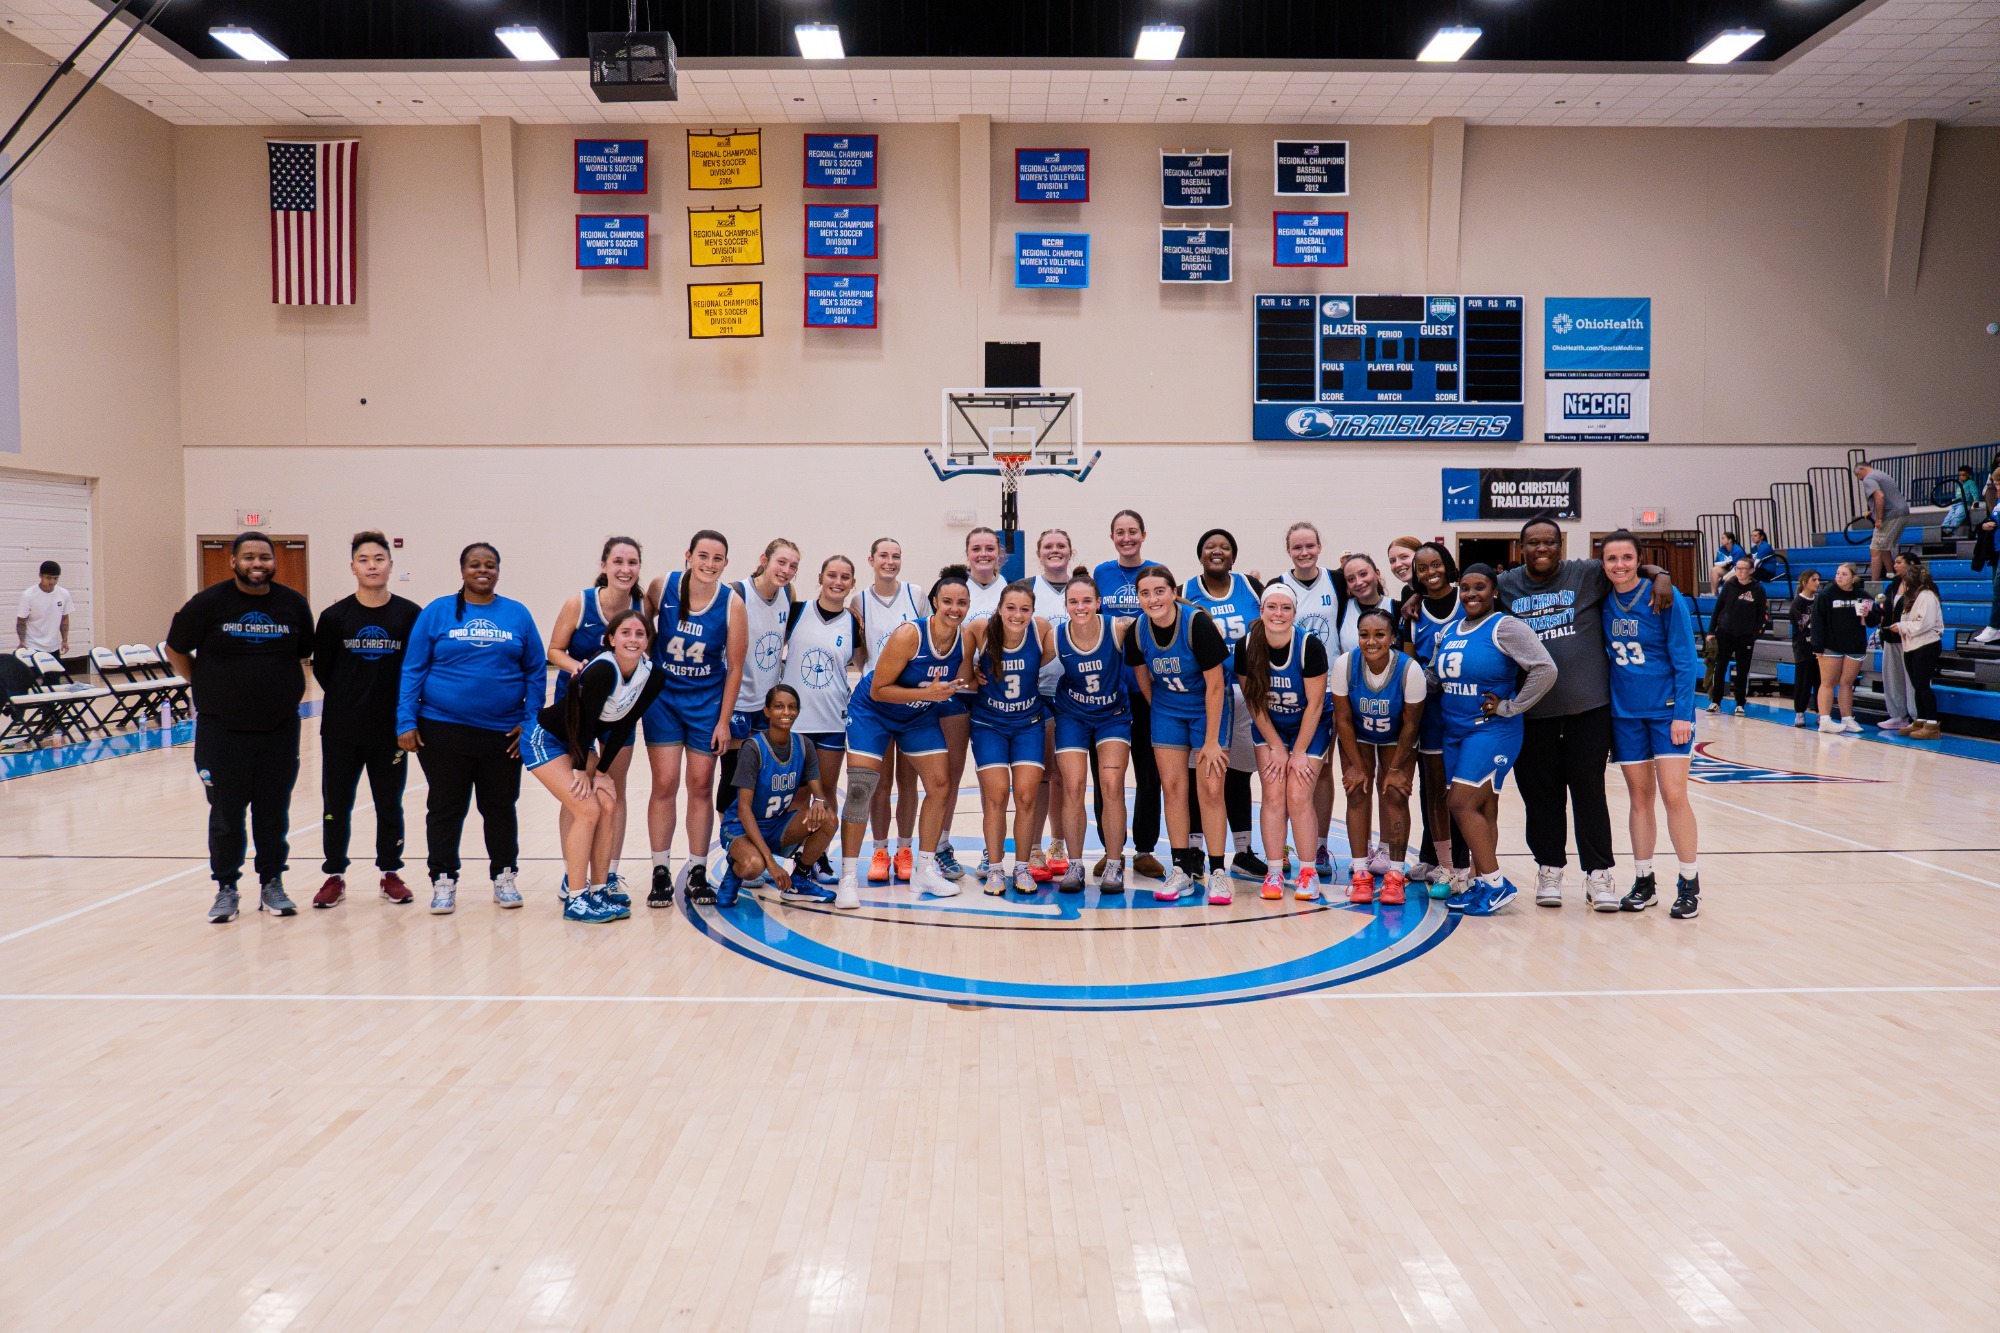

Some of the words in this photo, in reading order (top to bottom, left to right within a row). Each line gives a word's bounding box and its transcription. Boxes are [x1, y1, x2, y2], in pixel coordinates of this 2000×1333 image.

[723, 148, 757, 157] CHAMPIONS
[808, 150, 837, 158] REGIONAL
[722, 158, 746, 166] SOCCER
[710, 168, 735, 176] DIVISION
[1165, 169, 1193, 177] REGIONAL
[1194, 169, 1227, 177] CHAMPIONS
[1297, 166, 1326, 174] BASEBALL
[1182, 187, 1207, 195] DIVISION
[1190, 196, 1203, 204] 2010
[610, 231, 644, 239] CHAMPIONS
[694, 230, 723, 238] REGIONAL
[826, 238, 851, 246] DIVISION
[1042, 239, 1063, 247] NCCAA
[1164, 246, 1193, 254] REGIONAL
[1194, 247, 1228, 255] CHAMPIONS
[1295, 246, 1321, 254] DIVISION
[1020, 258, 1048, 266] WOMEN'S
[1182, 263, 1207, 271] DIVISION
[839, 290, 873, 298] CHAMPIONS
[694, 300, 721, 308] REGIONAL
[1576, 318, 1644, 329] OhioHealth
[1323, 324, 1367, 335] BLAZERS
[1377, 330, 1403, 338] PERIOD
[1420, 325, 1454, 335] GUEST
[1322, 363, 1344, 371] FOULS
[1564, 393, 1630, 415] NCCAA
[1330, 414, 1511, 437] TRAILBLAZERS
[1491, 482, 1516, 494] OHIO
[1519, 482, 1570, 494] CHRISTIAN
[1491, 496, 1570, 508] TRAILBLAZERS
[1103, 596, 1116, 604] OHIO
[1321, 595, 1331, 606] 10
[1512, 596, 1530, 613] OHIO
[1531, 590, 1574, 610] CHRISTIAN
[1211, 604, 1235, 615] OHIO
[779, 611, 786, 623] 14
[223, 623, 242, 631] OHIO
[245, 624, 289, 633] CHRISTIAN
[1612, 619, 1638, 636] OCU
[449, 629, 468, 638] OHIO
[470, 629, 512, 640] CHRISTIAN
[362, 639, 401, 650] CHRISTIAN
[666, 636, 706, 663] 44
[1444, 640, 1468, 650] OHIO
[1612, 641, 1645, 666] 33
[1078, 660, 1102, 673] OHIO
[1153, 657, 1181, 674] OCU
[1438, 652, 1464, 679] 13
[1004, 674, 1020, 699] 3
[1085, 674, 1100, 694] 5
[1360, 697, 1390, 715] OCU
[772, 772, 796, 791] OCU
